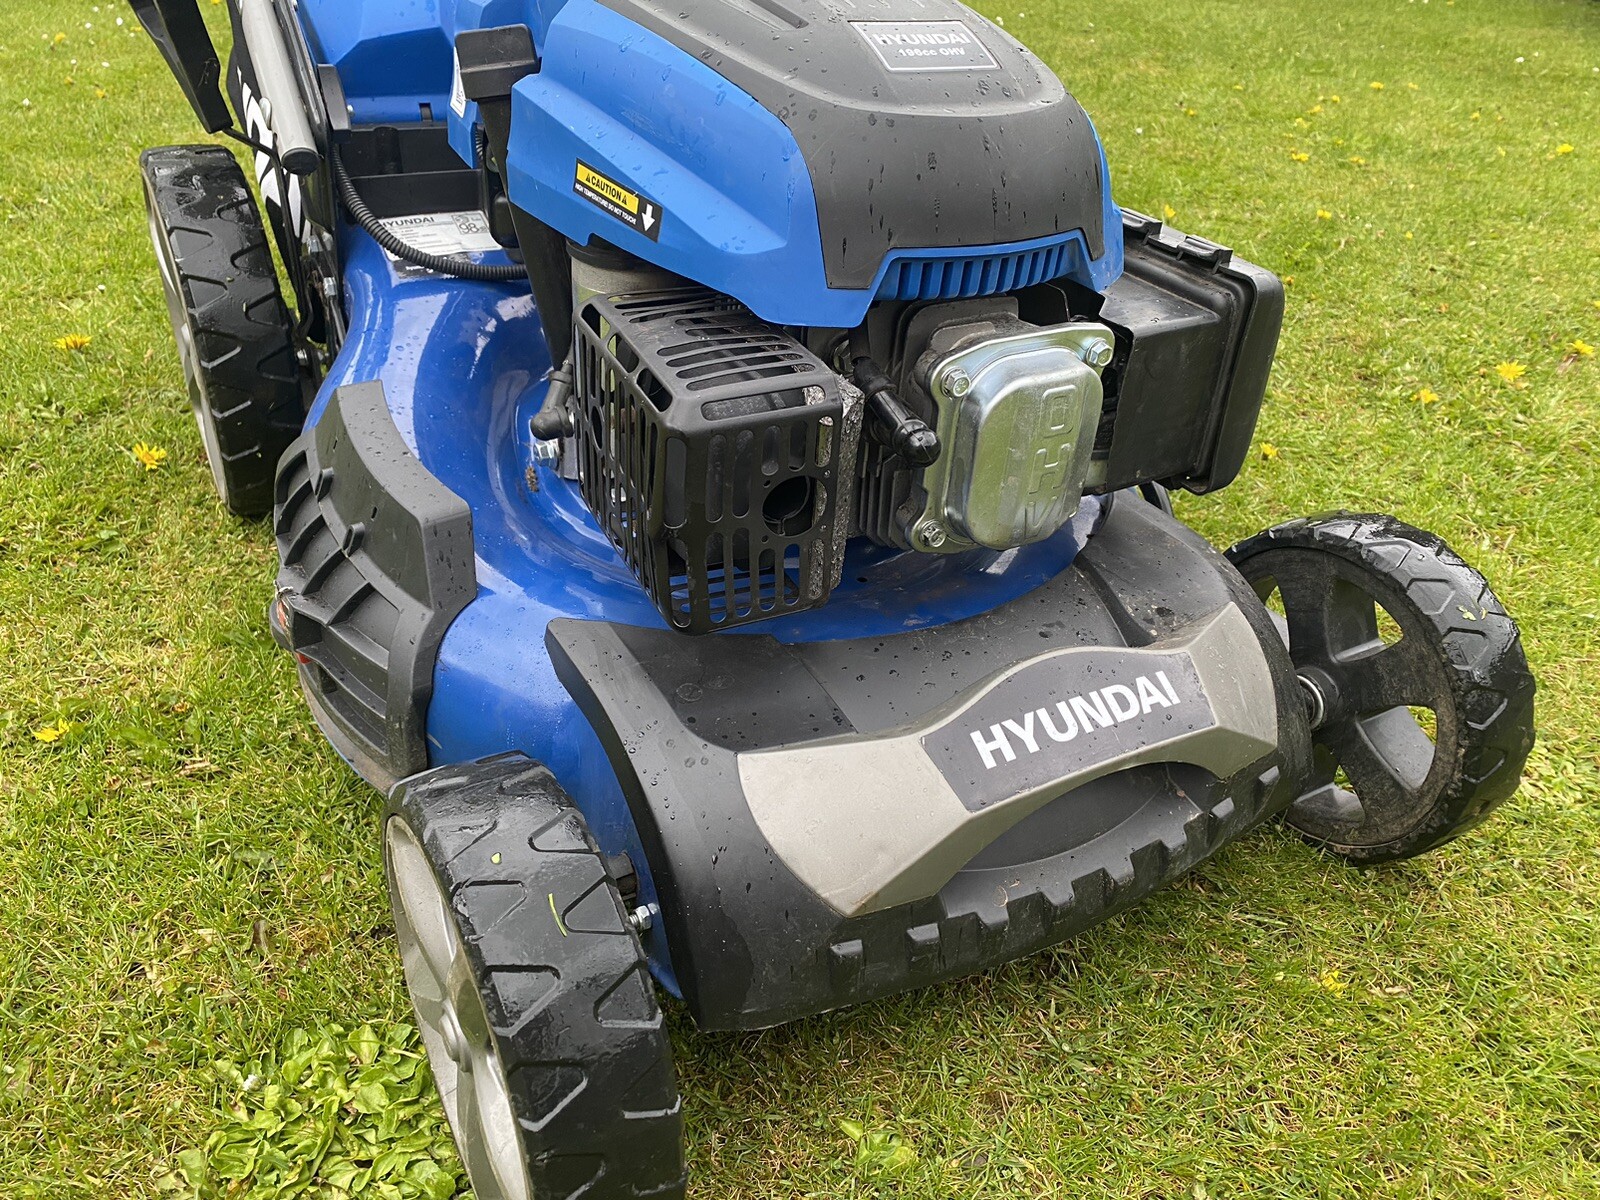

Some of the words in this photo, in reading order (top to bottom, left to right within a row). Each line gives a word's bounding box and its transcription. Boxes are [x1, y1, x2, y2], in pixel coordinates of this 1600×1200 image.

[872, 33, 971, 45] HYUNDAI
[939, 47, 966, 56] OHV
[591, 175, 622, 201] CAUTION
[458, 222, 479, 234] 98
[1024, 384, 1077, 539] OHV
[970, 670, 1182, 770] HYUNDAI
